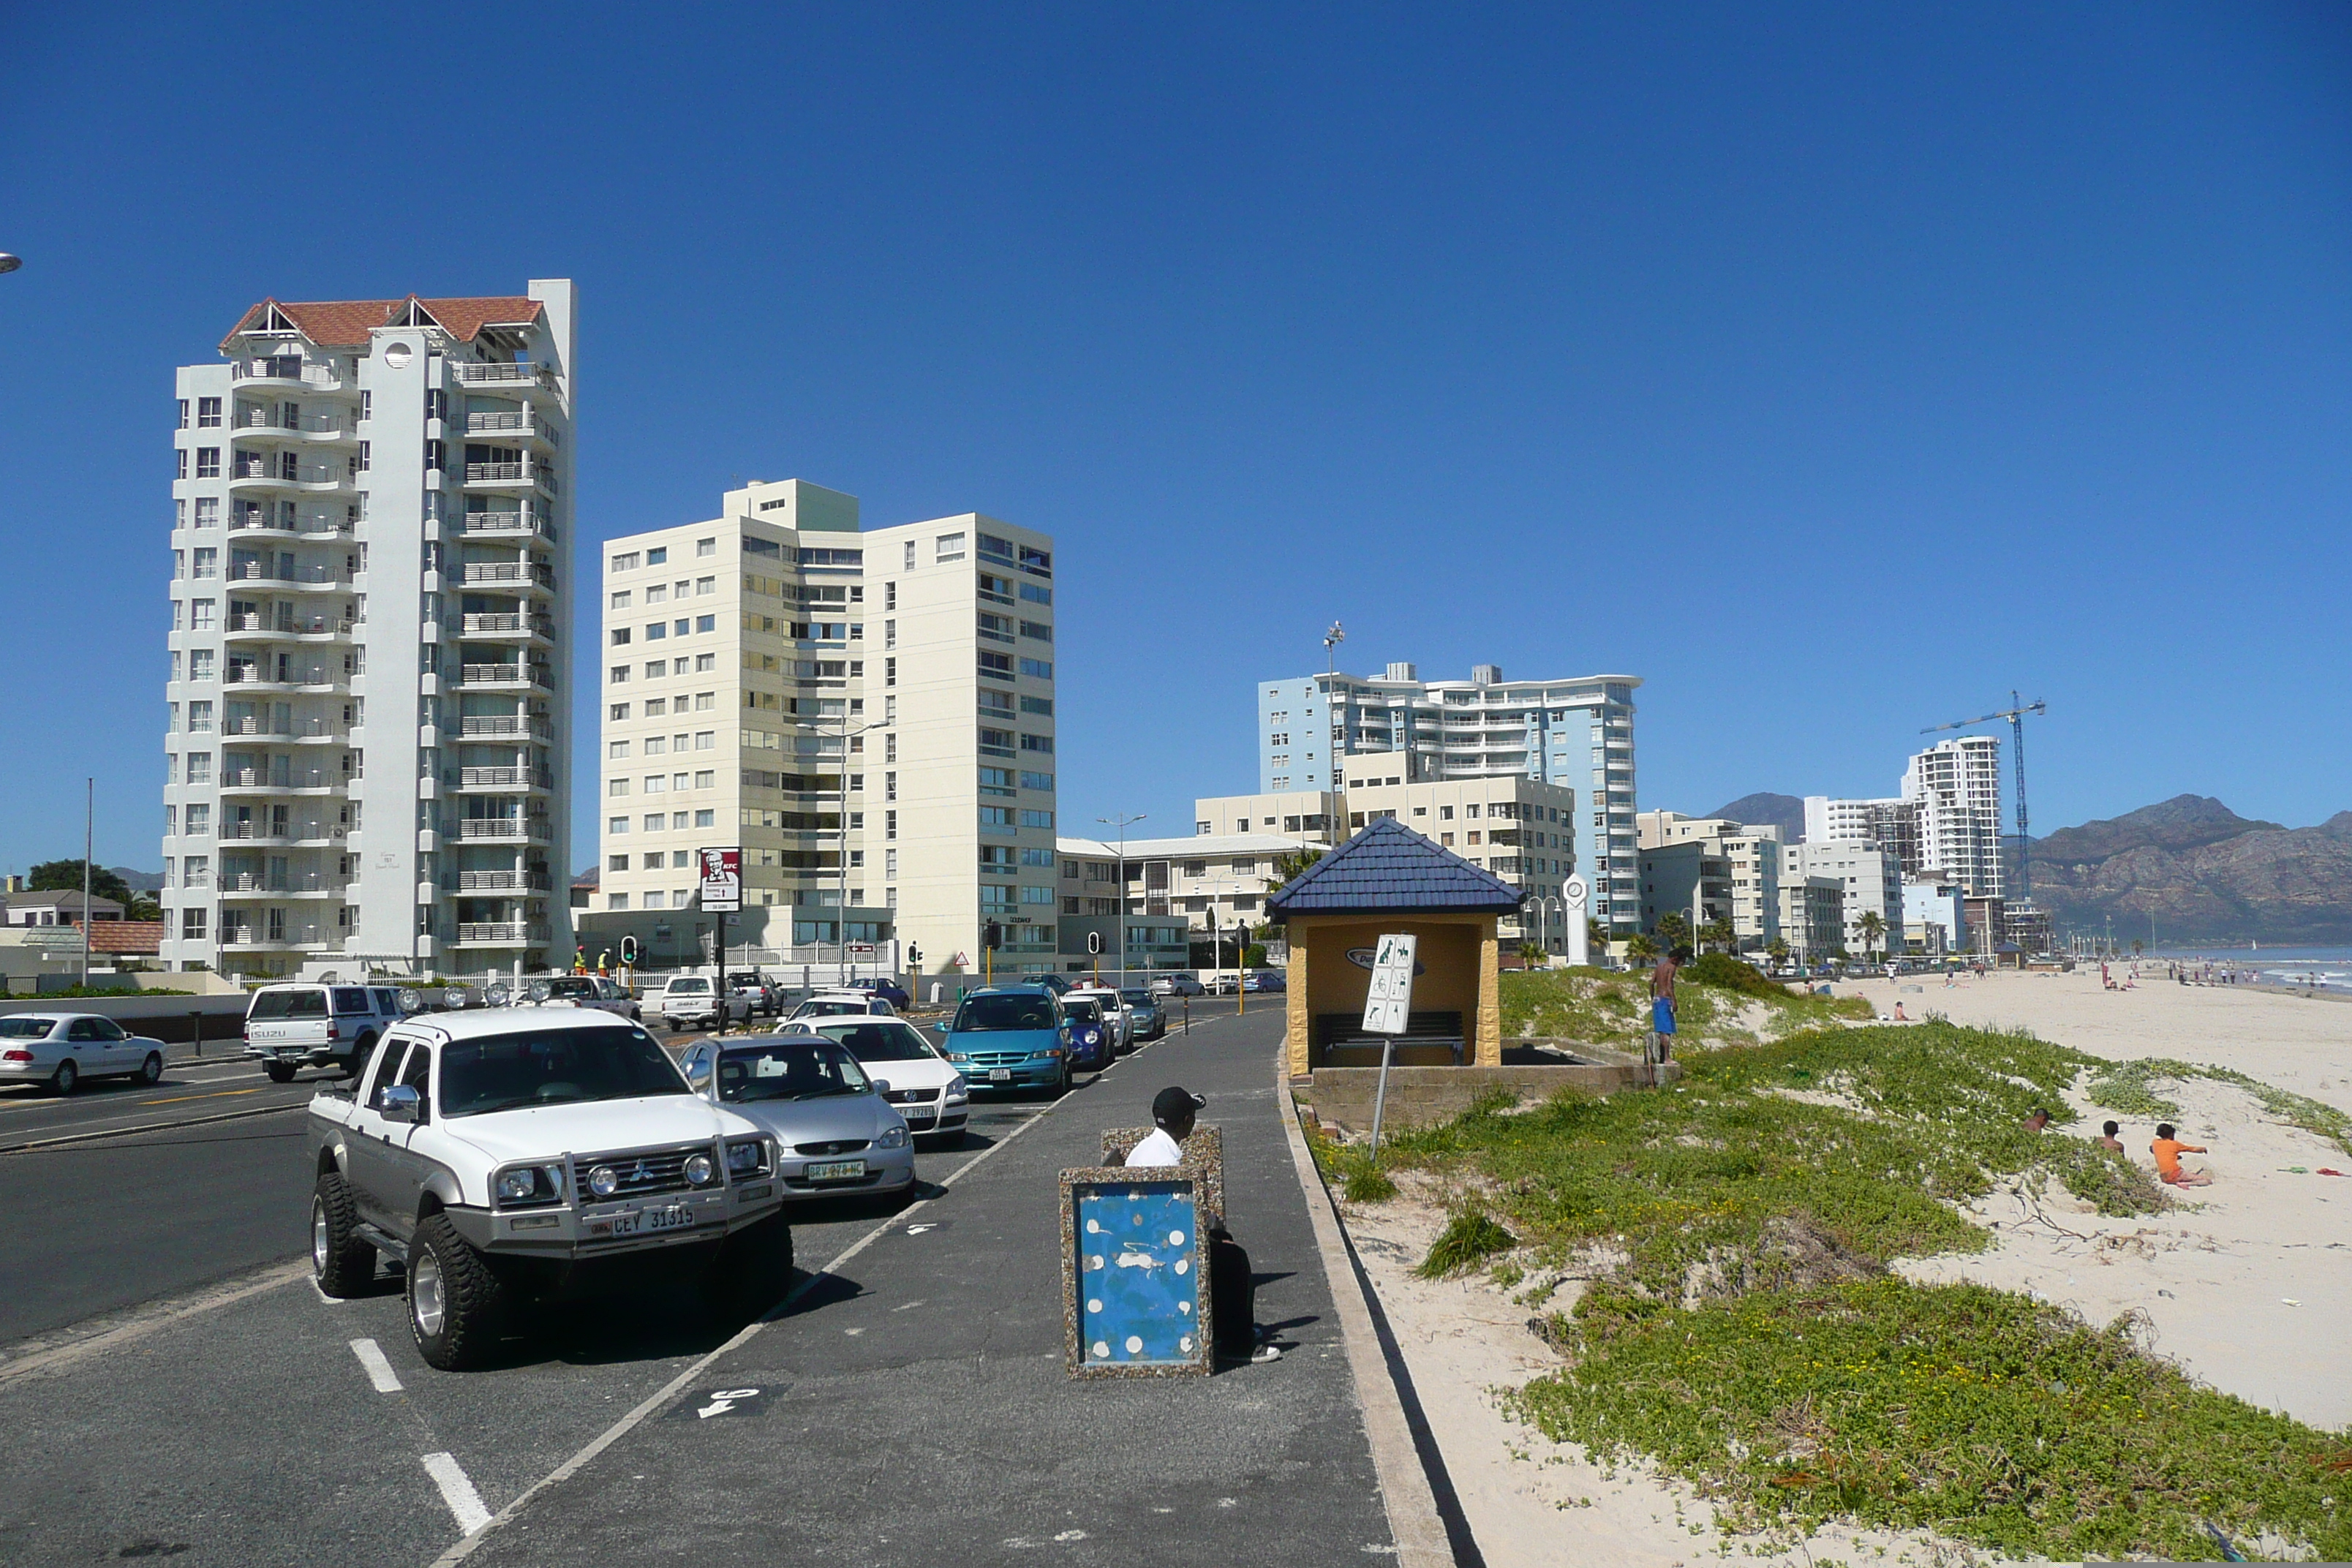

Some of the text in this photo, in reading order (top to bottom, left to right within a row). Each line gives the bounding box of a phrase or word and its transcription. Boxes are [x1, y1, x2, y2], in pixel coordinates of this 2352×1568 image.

[251, 1030, 286, 1039] ISUZU
[851, 1163, 862, 1175] NC
[614, 1210, 693, 1233] CEY 31315
